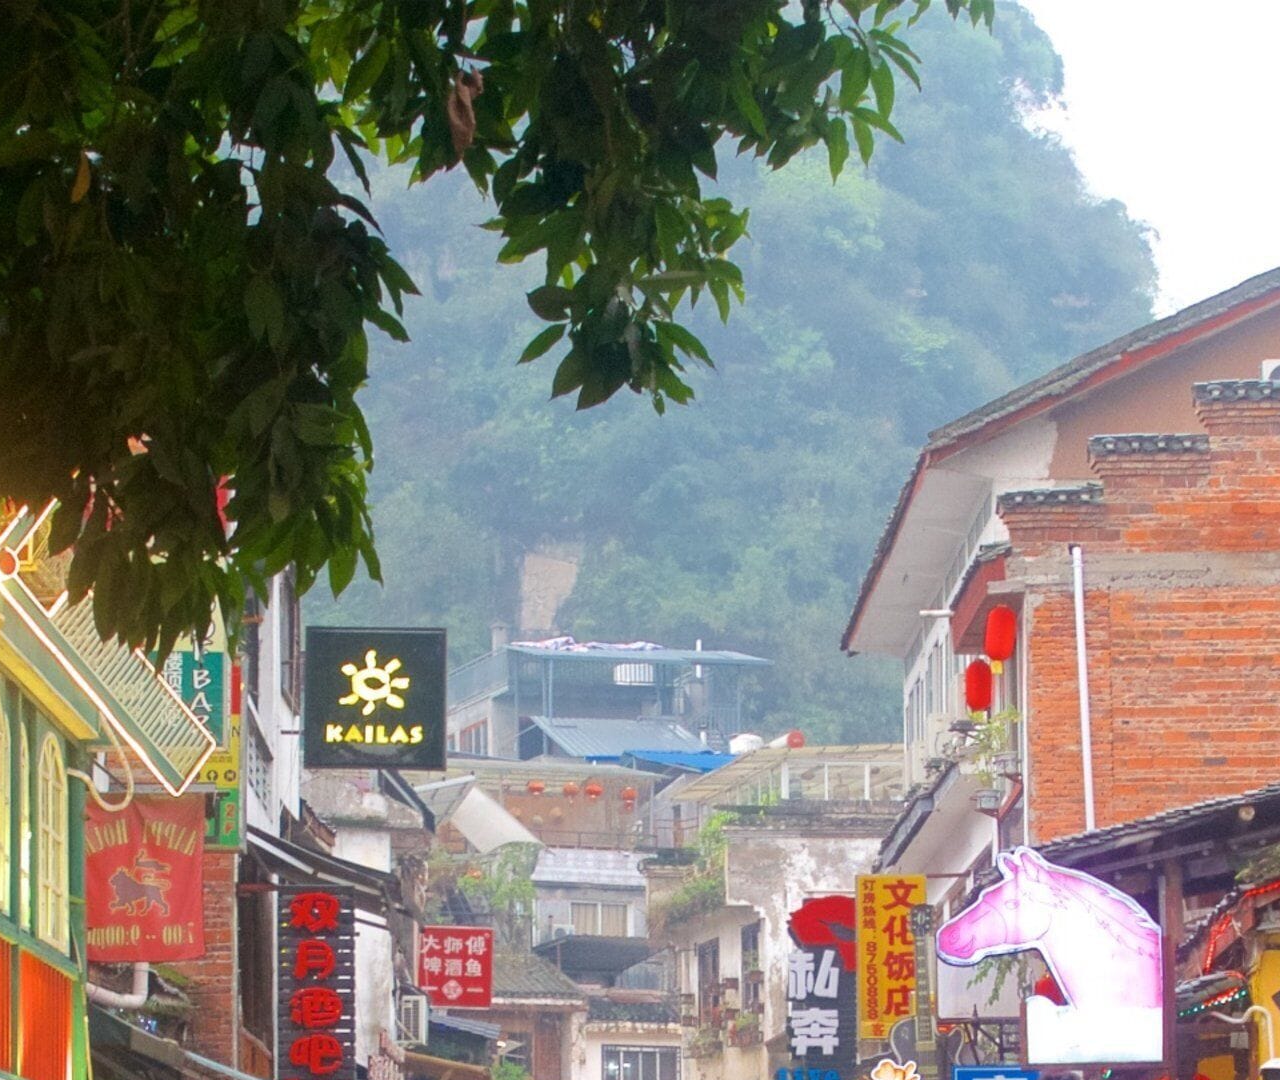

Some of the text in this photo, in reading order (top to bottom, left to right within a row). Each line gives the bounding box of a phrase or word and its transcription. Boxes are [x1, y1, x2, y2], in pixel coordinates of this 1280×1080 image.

[325, 724, 424, 744] KAILAS
[288, 891, 344, 1076] 双月酒吧
[788, 950, 840, 1056] 私奔
[882, 879, 918, 1017] 文化饭店
